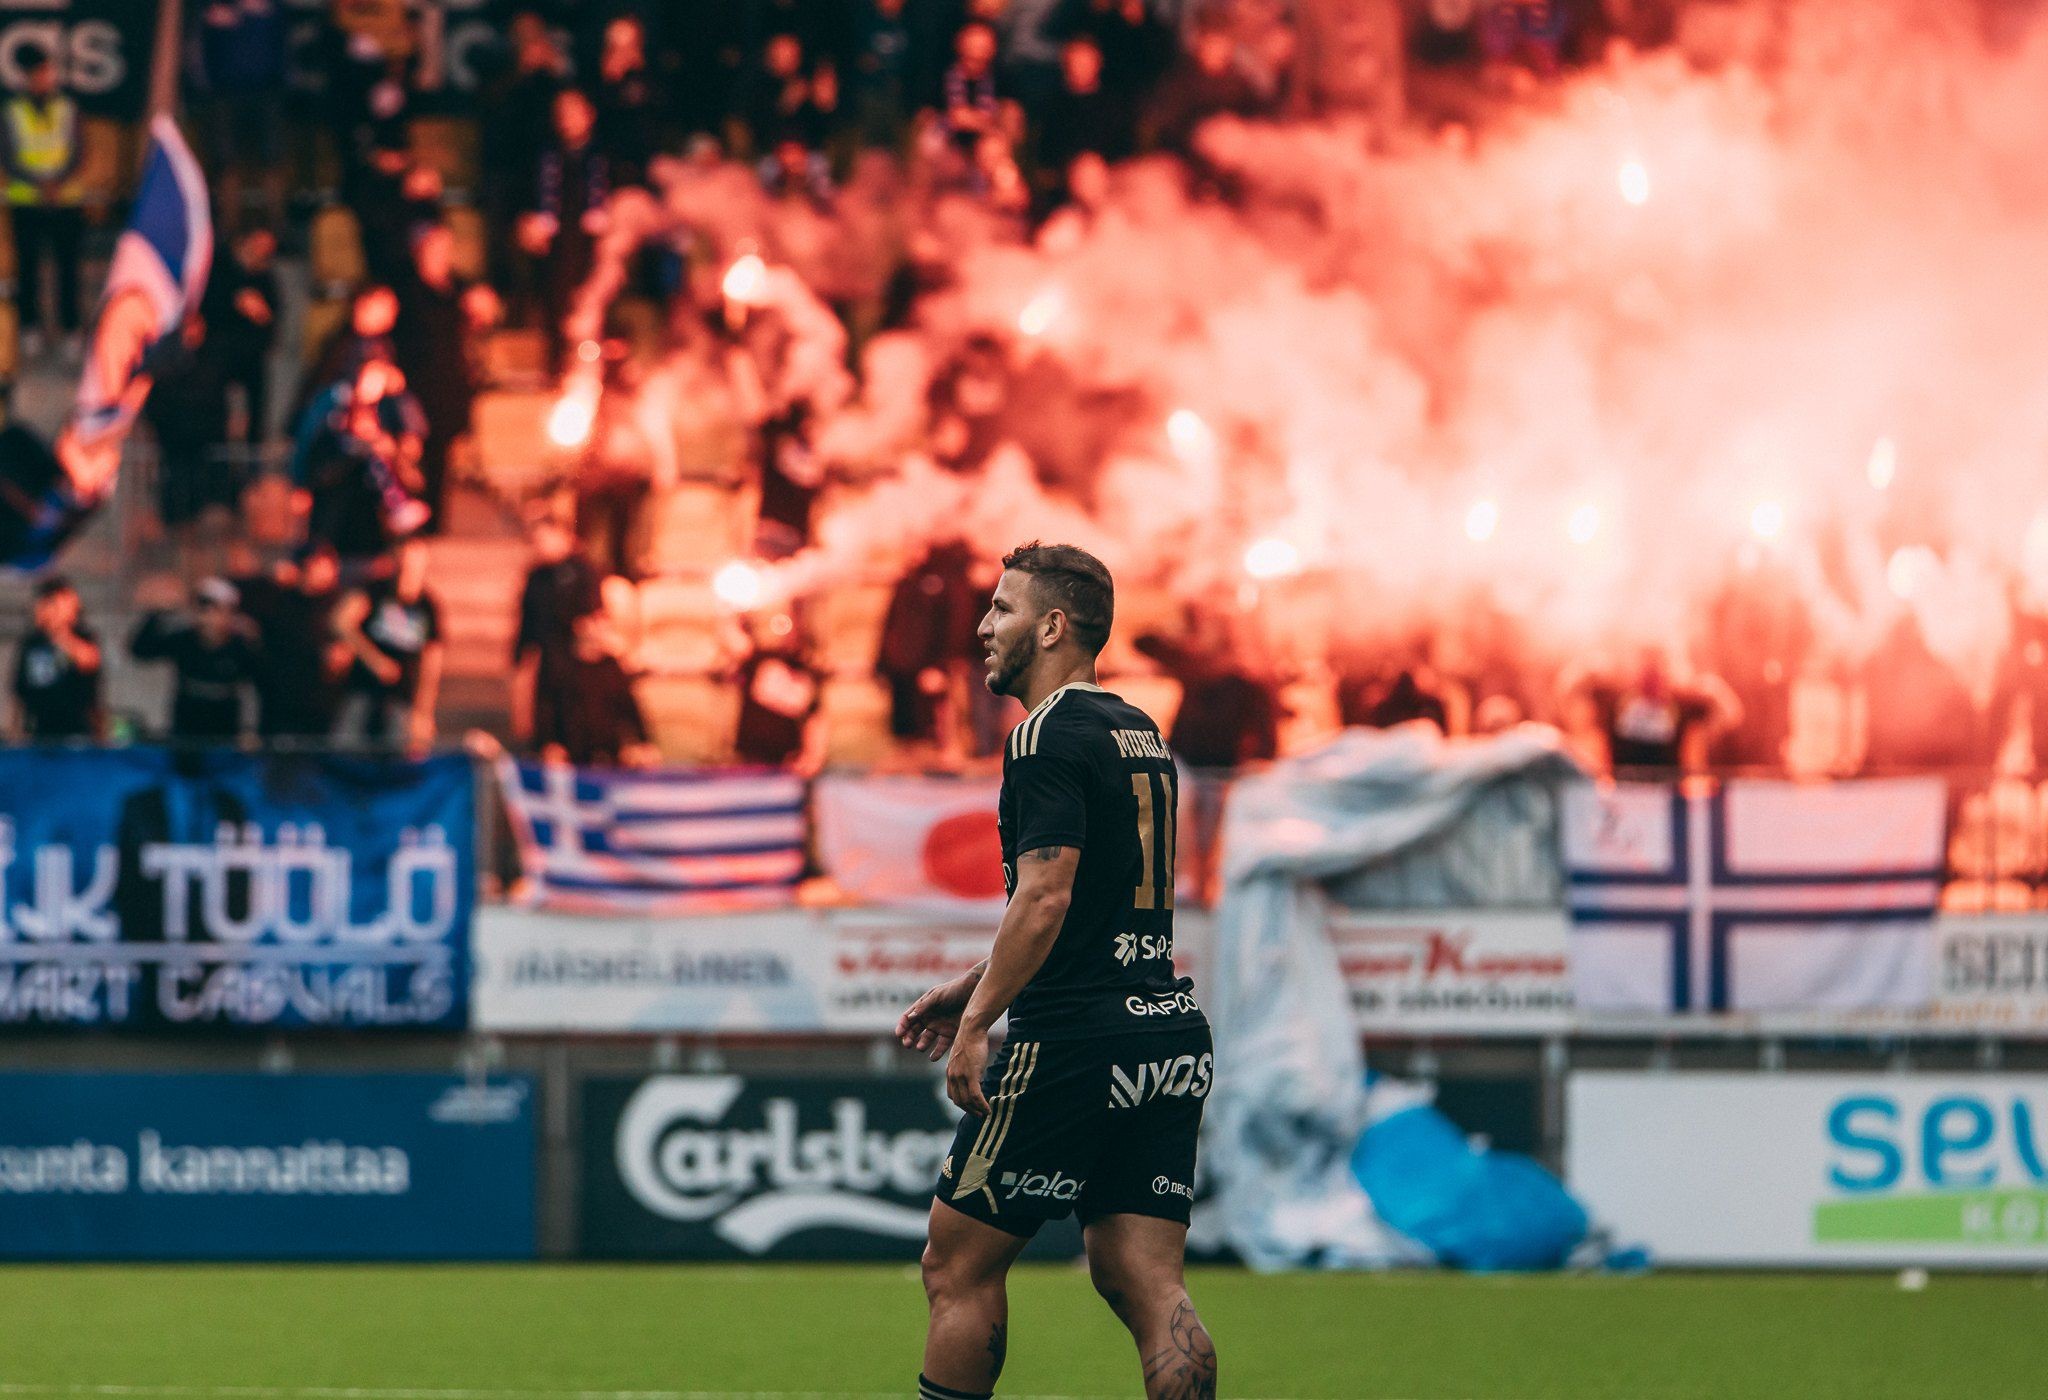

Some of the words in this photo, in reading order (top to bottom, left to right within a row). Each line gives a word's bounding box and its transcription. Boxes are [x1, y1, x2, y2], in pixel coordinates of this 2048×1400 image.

[140, 820, 457, 942] TÖÖLÖ
[1131, 772, 1174, 910] 11
[138, 1127, 411, 1194] kannattaa
[1170, 1182, 1186, 1196] DBC
